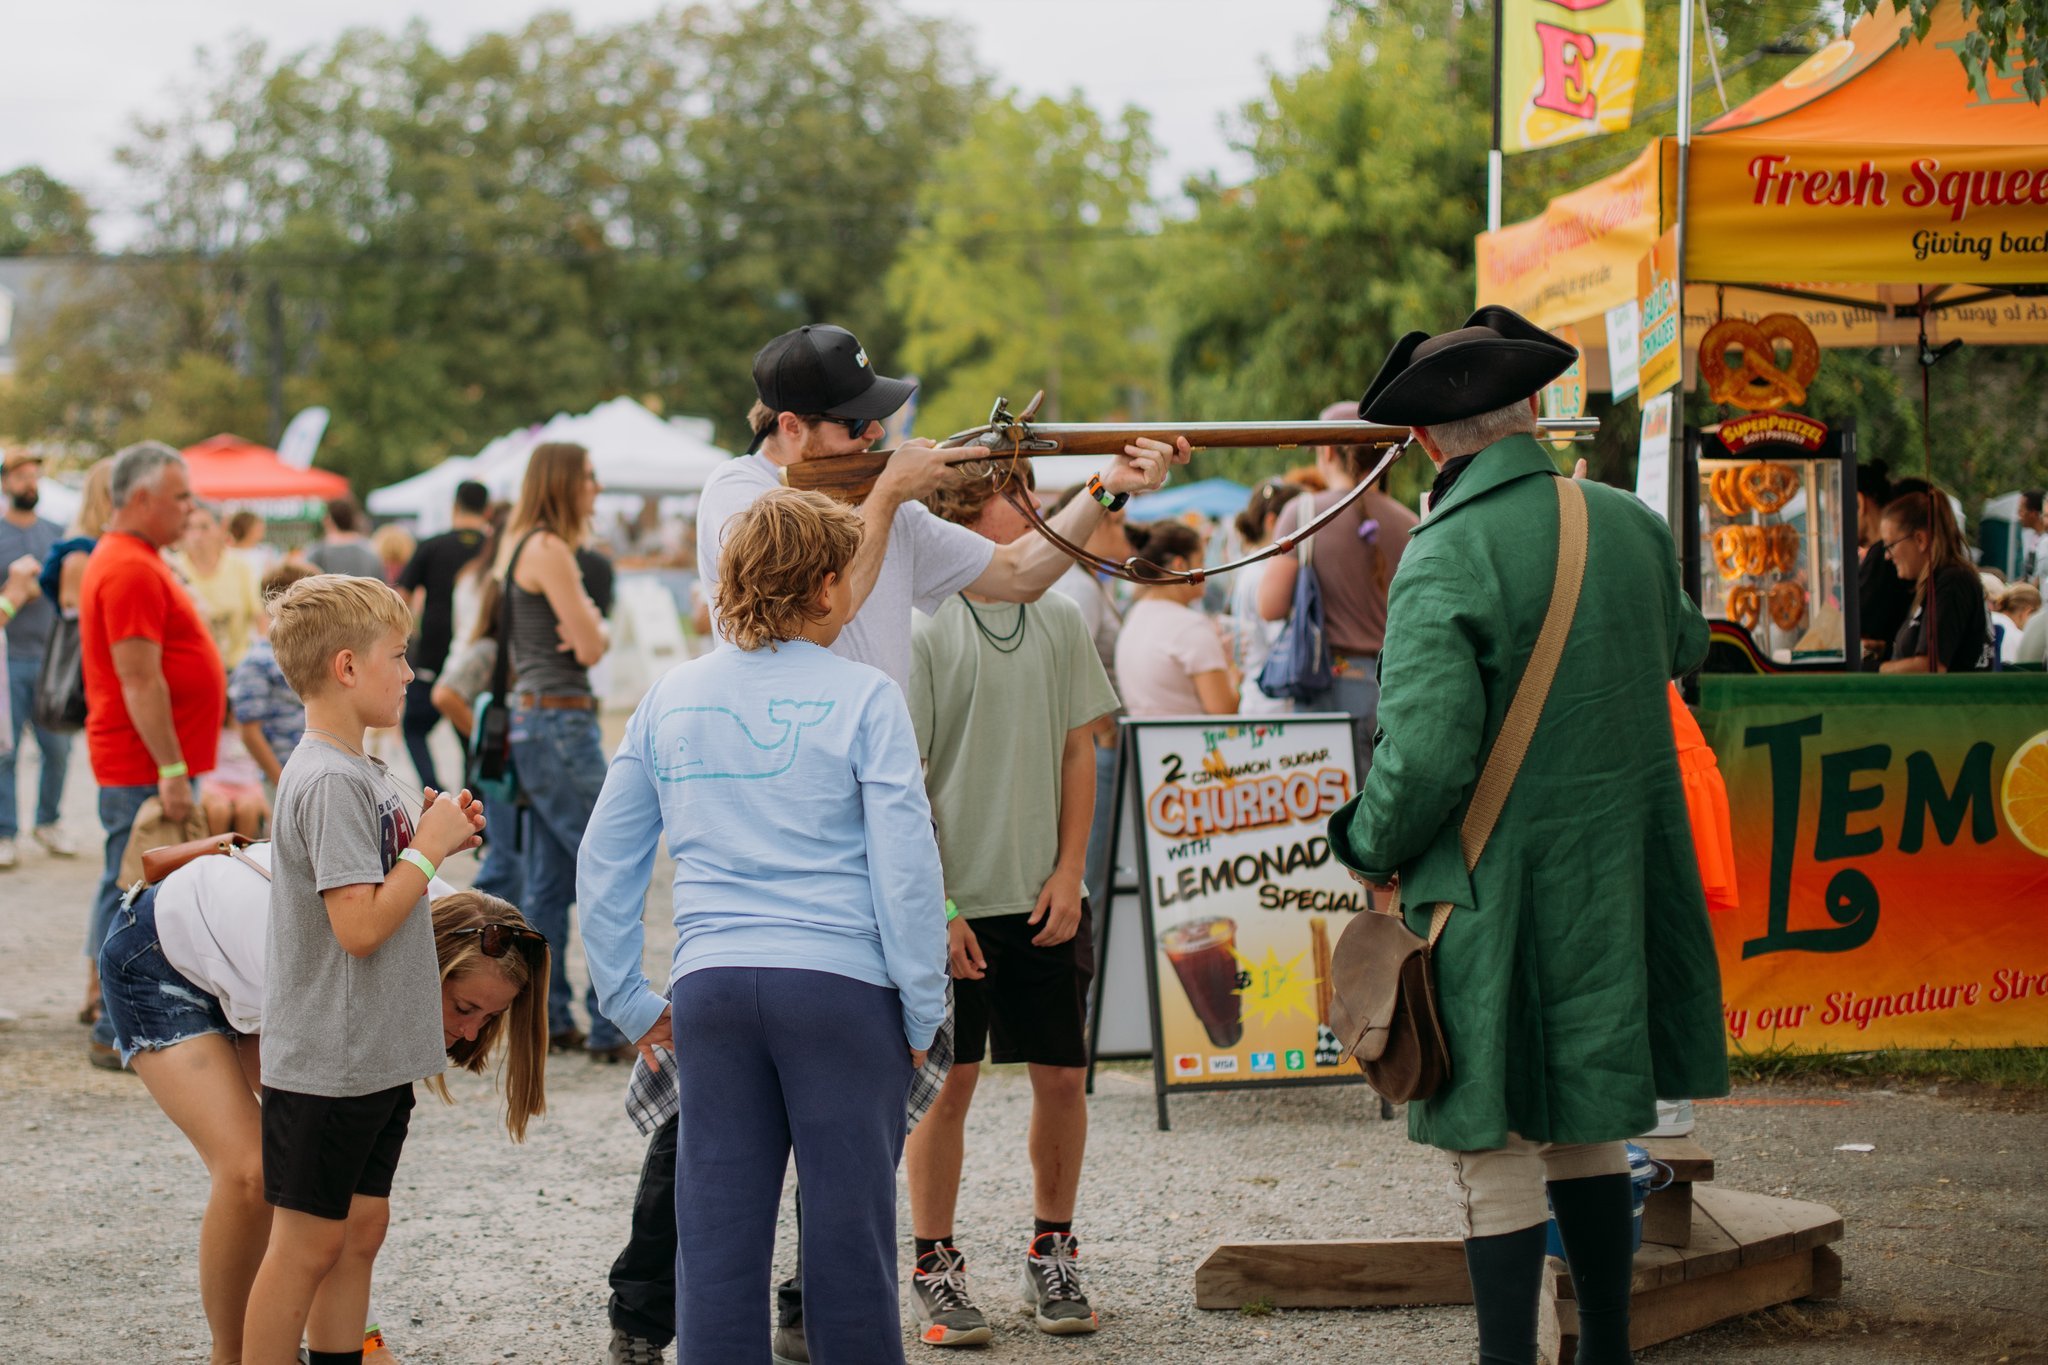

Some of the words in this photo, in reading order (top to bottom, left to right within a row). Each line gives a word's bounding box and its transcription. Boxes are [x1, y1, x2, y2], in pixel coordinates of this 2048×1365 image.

[1748, 154, 1888, 207] Fresh
[1902, 158, 2048, 222] Squee
[1912, 229, 1993, 262] Giving
[1161, 754, 1186, 784] 2
[1192, 759, 1271, 785] CINNAMON
[1279, 748, 1331, 770] SUGAR
[1148, 768, 1350, 838] CHURROS
[1167, 838, 1211, 861] WITH
[1259, 884, 1365, 912] SPECIAL
[1756, 1001, 1813, 1030] our
[1820, 981, 1982, 1031] Signature
